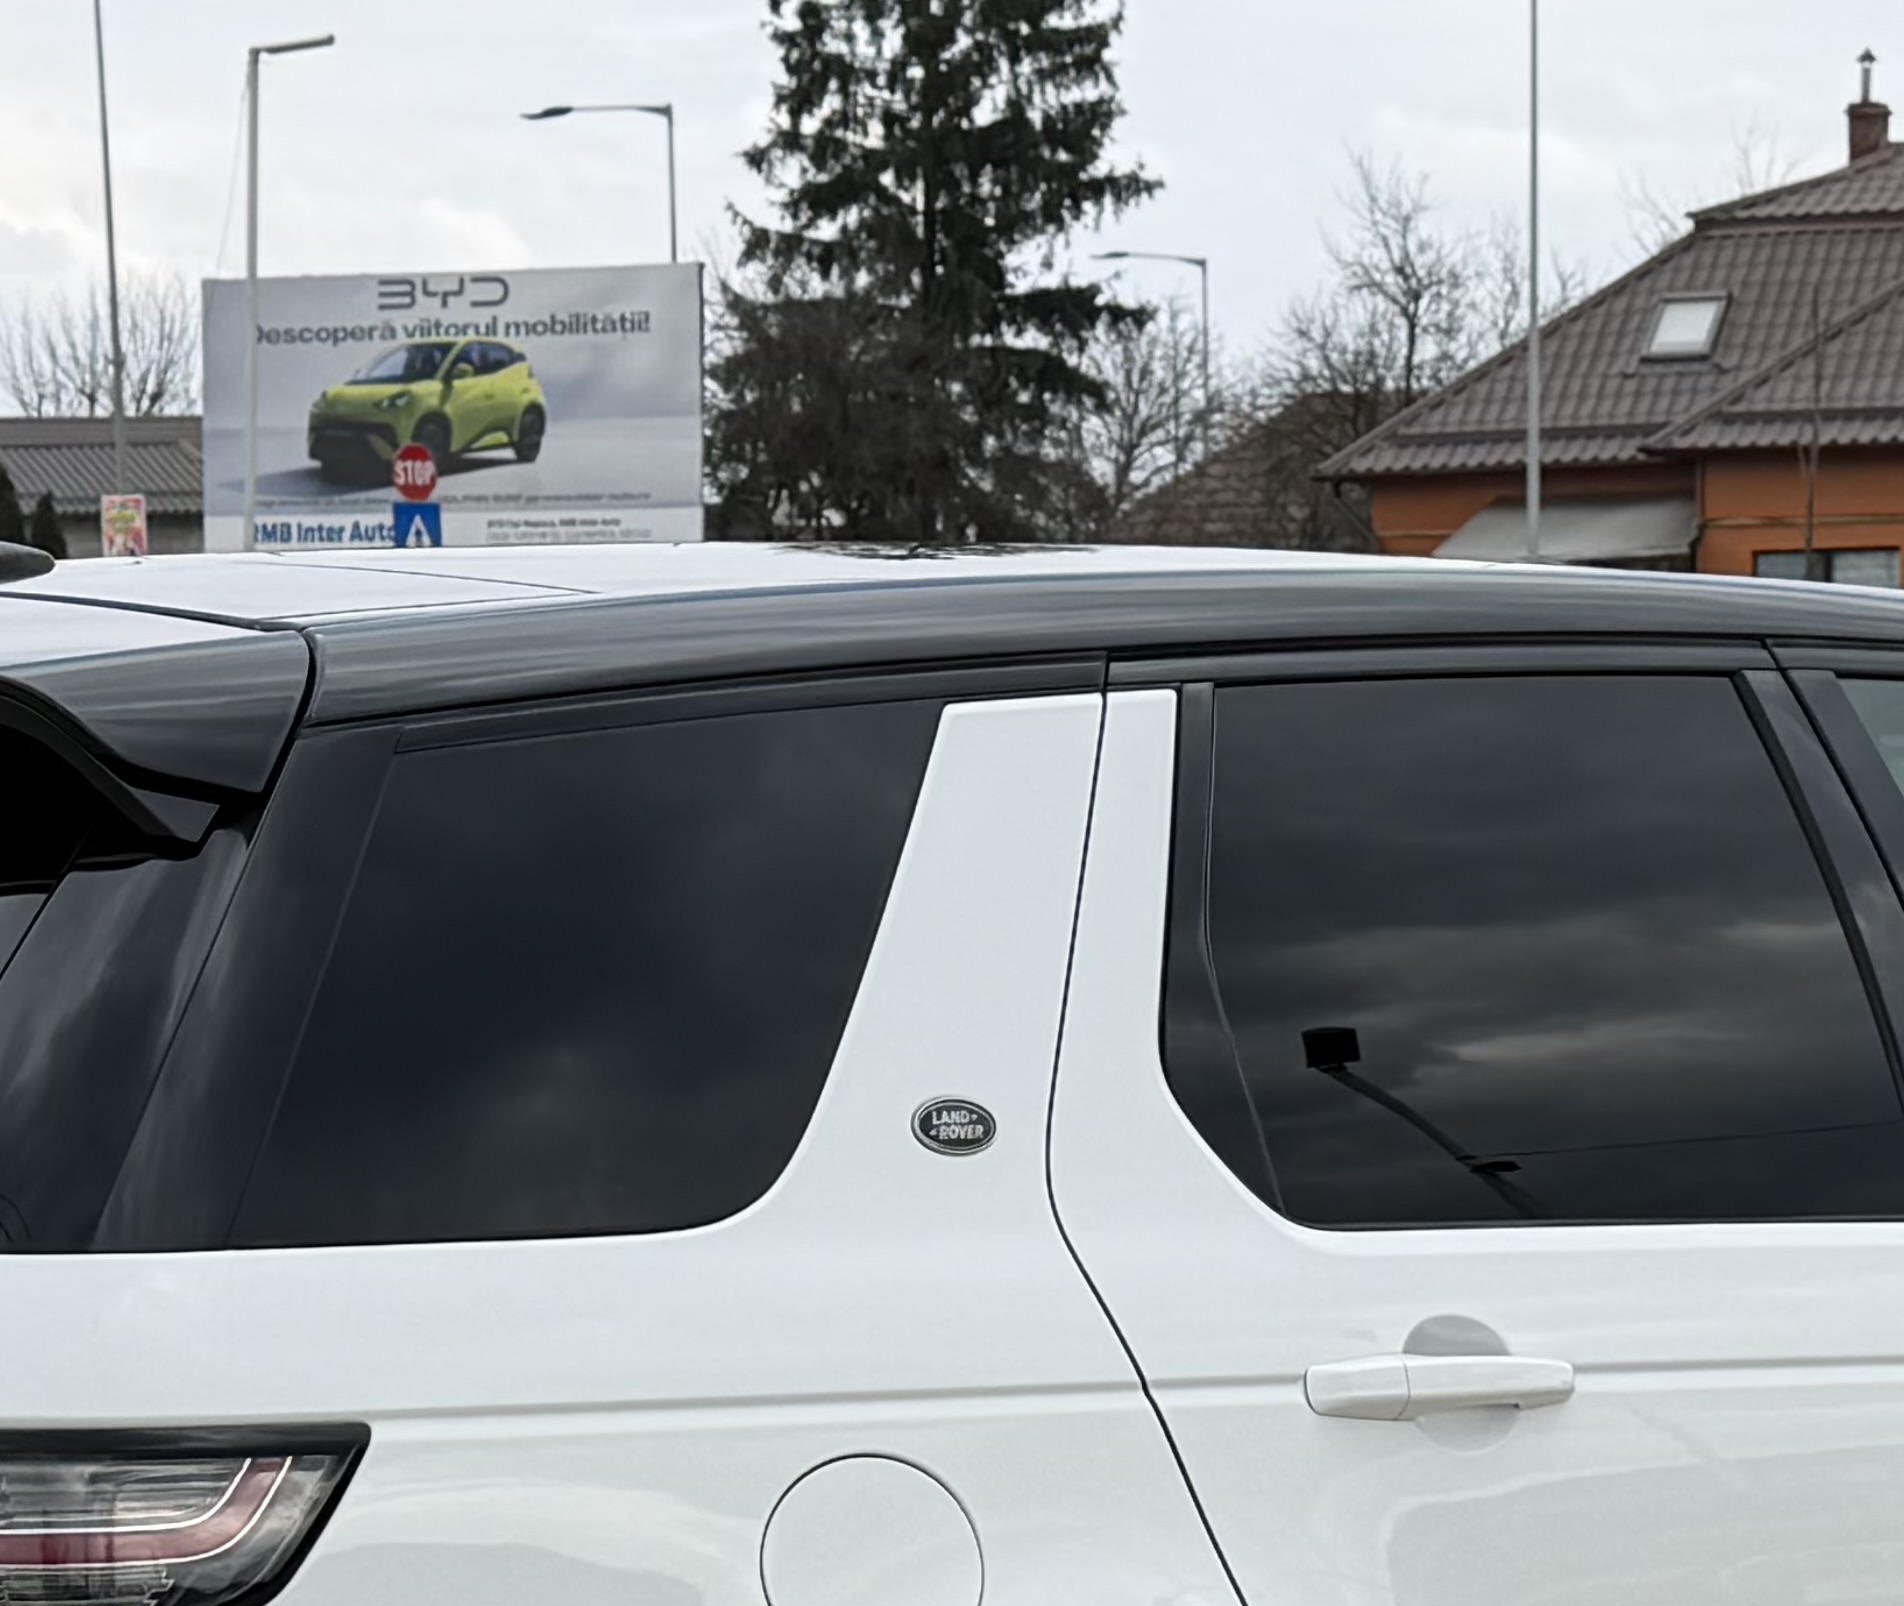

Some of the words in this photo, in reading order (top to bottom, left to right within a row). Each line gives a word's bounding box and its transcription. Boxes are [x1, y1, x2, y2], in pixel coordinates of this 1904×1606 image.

[377, 275, 510, 310] BYD
[401, 315, 498, 341] viitorul
[394, 459, 435, 486] STOP
[296, 521, 345, 543] Inter
